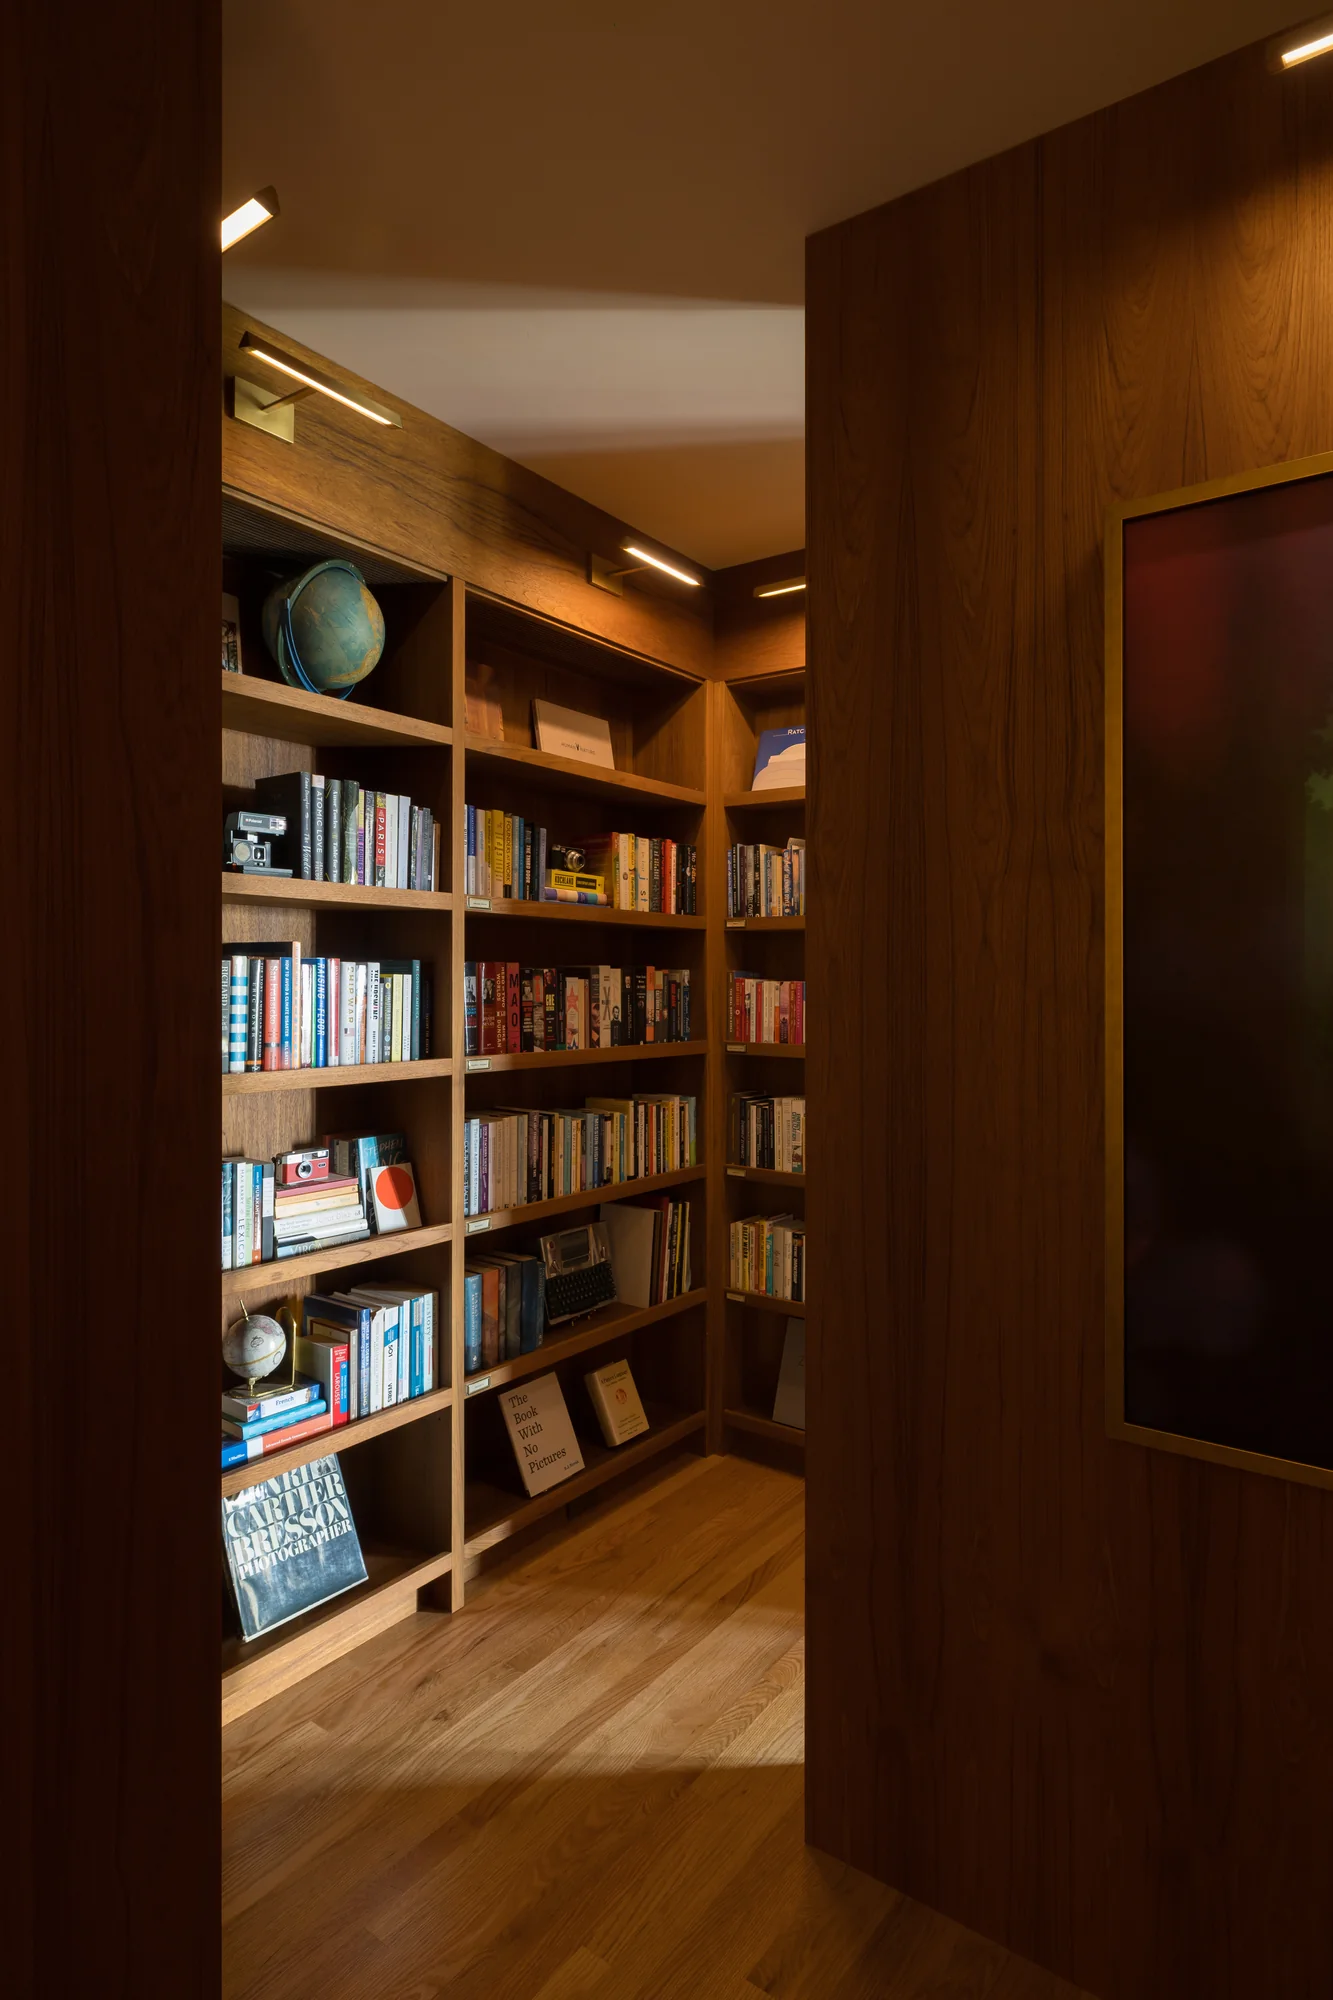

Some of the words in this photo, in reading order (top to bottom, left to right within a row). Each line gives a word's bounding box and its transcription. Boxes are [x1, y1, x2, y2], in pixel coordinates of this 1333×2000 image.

[303, 846, 311, 874] Wonder
[270, 965, 278, 981] San
[317, 963, 325, 999] RAISING
[509, 974, 519, 1027] MAO
[317, 1008, 325, 1036] FLOOR
[424, 1311, 432, 1336] story
[275, 1396, 294, 1406] French
[508, 1394, 528, 1408] The
[513, 1406, 538, 1425] Book
[517, 1422, 543, 1440] With
[266, 1440, 281, 1448] Advanced
[523, 1443, 539, 1458] No
[528, 1448, 567, 1474] Pictures
[226, 1473, 346, 1538] CARTIER
[232, 1495, 349, 1565] BRESSON
[238, 1519, 352, 1580] PHOTOGRAPHER
